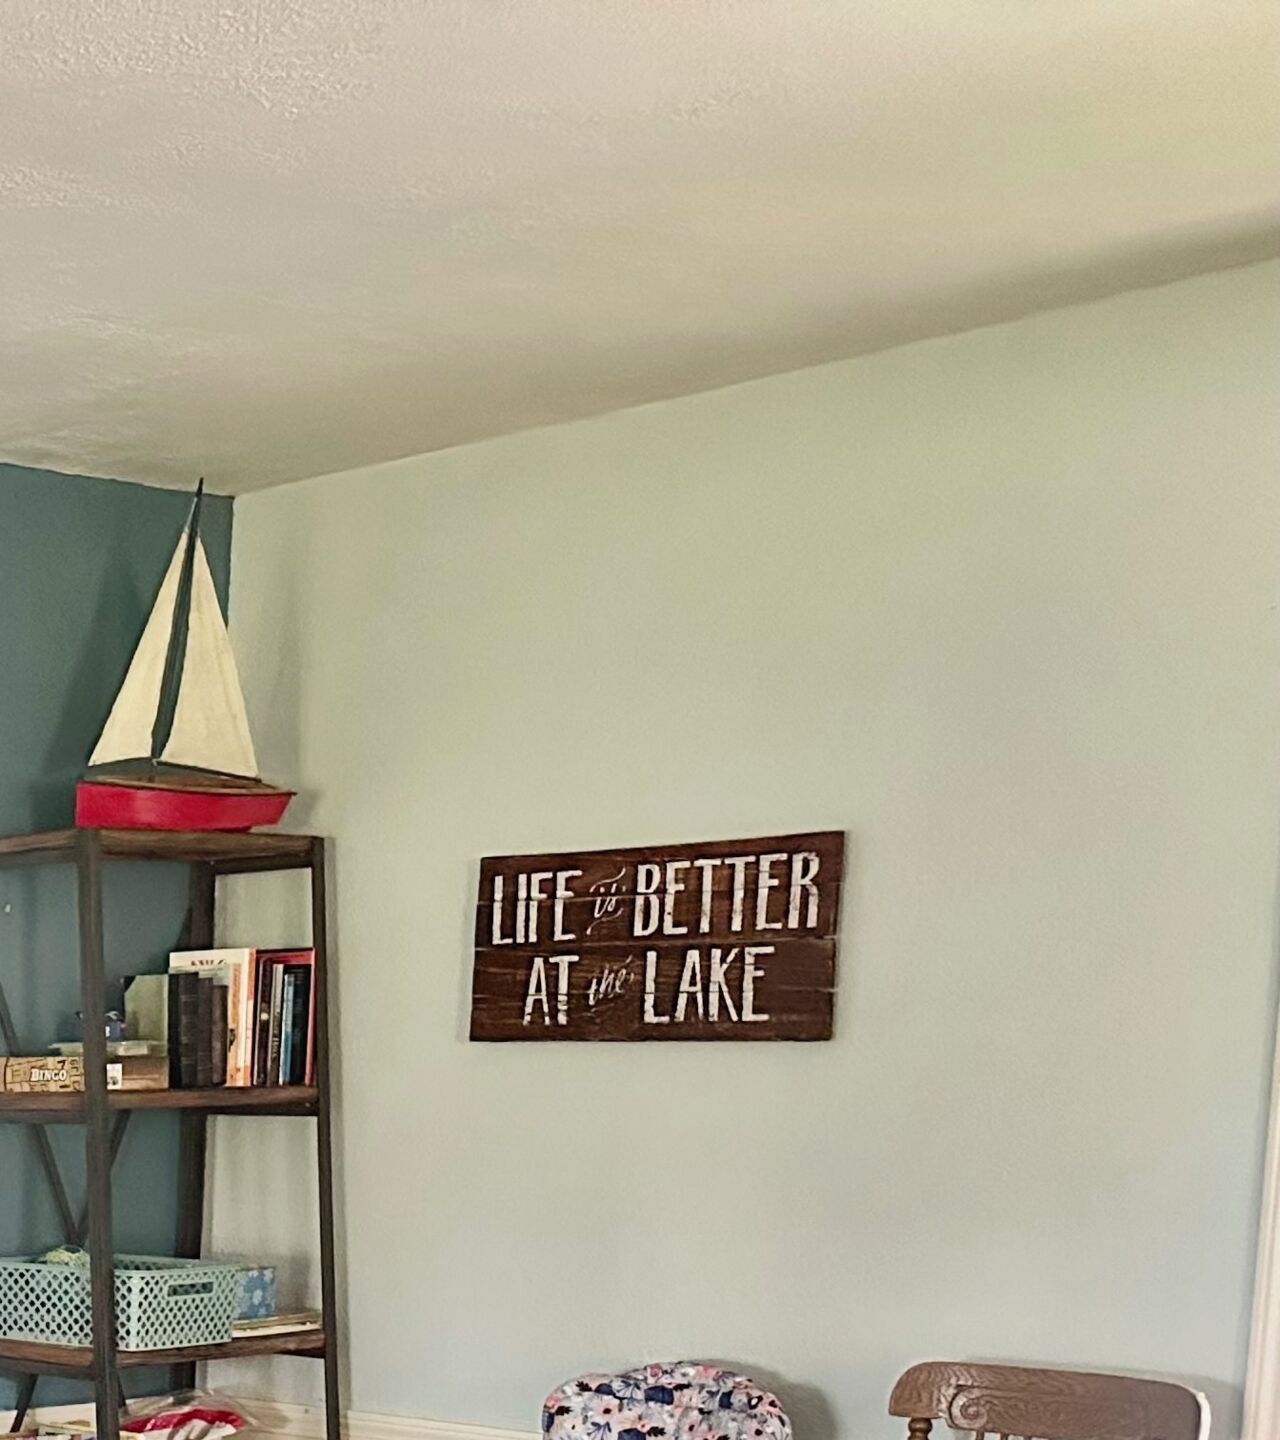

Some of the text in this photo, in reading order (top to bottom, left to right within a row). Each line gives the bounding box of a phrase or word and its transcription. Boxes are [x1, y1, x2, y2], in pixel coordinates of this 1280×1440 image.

[491, 869, 583, 945] LIFE
[633, 851, 821, 937] BETTER
[522, 945, 776, 1027] AT the LAKE
[30, 1067, 68, 1082] BINGO
